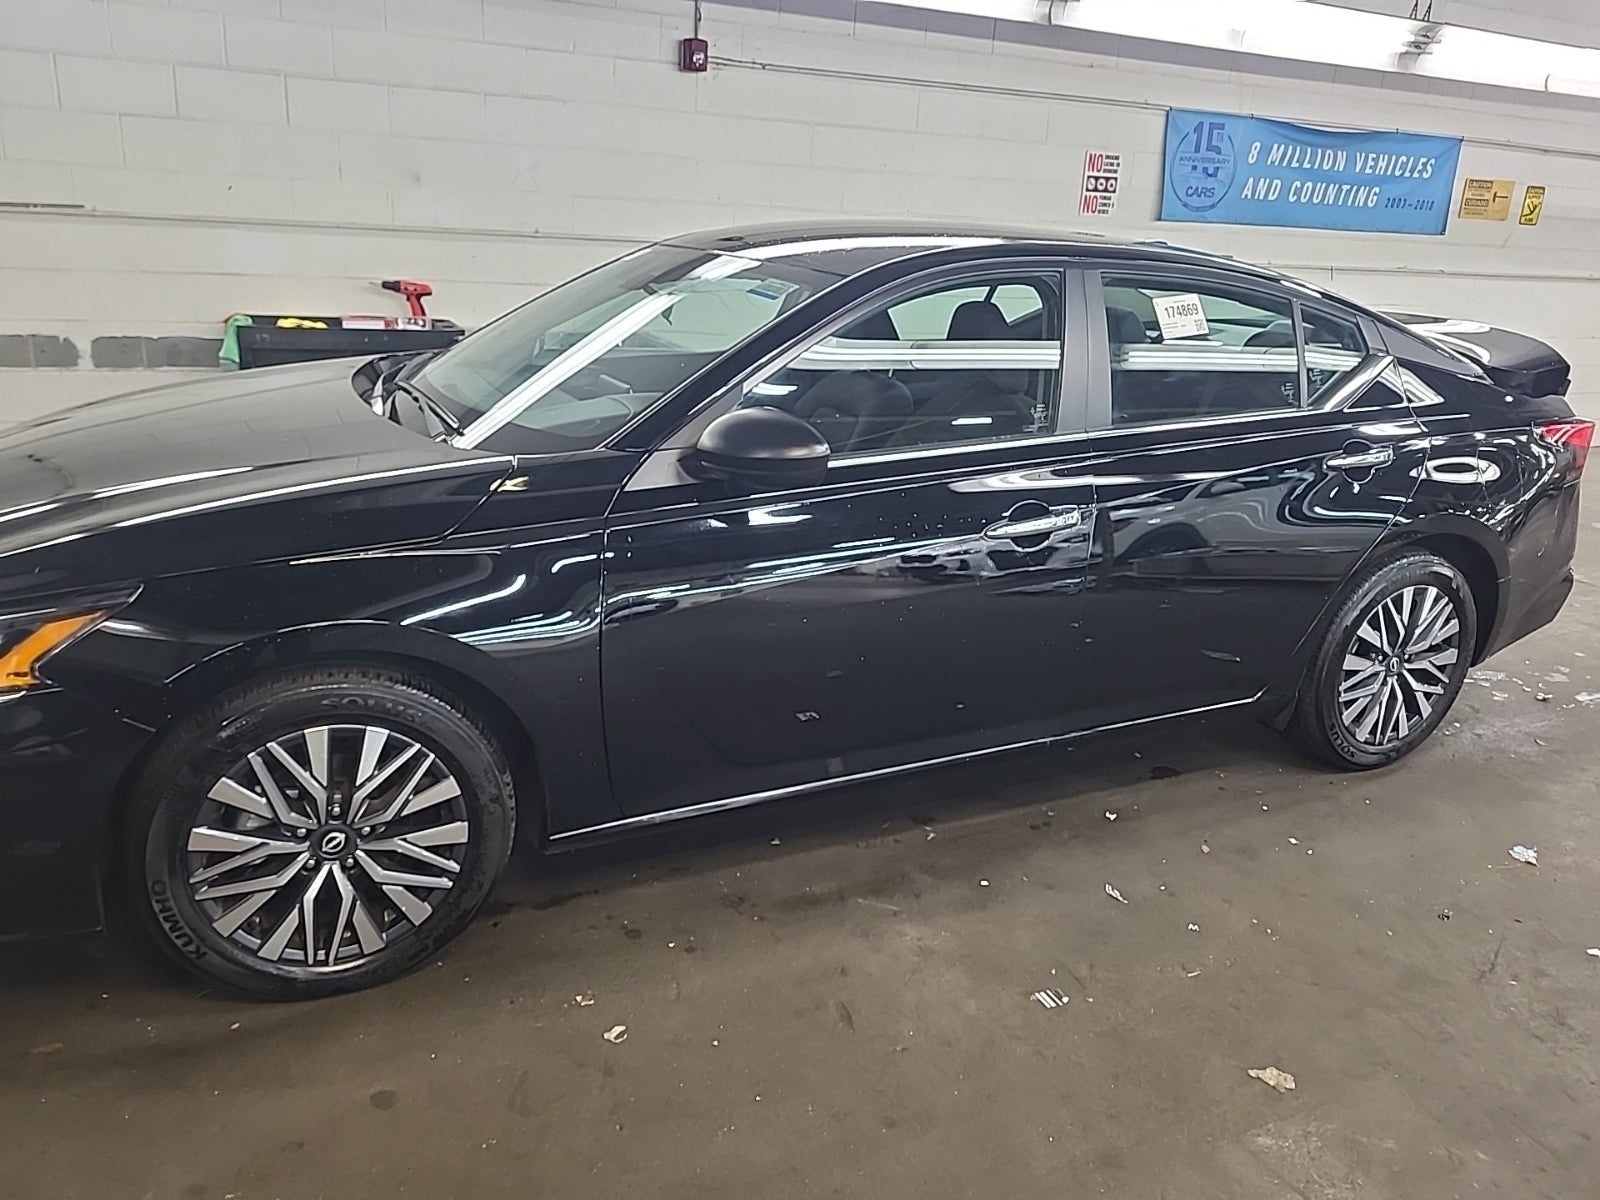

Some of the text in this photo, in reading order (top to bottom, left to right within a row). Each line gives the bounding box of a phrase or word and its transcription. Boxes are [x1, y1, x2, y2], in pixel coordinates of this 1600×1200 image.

[1088, 153, 1104, 173] NO
[1179, 155, 1231, 165] ANNIVERSARY
[1248, 141, 1435, 179] 8 MILLION VEHICLES
[1186, 186, 1215, 198] CARS
[1241, 177, 1281, 201] AND
[1289, 180, 1380, 208] COUNTING
[1082, 194, 1098, 214] NO
[1164, 303, 1199, 319] 174869
[1329, 722, 1356, 759] SOLUS
[152, 880, 208, 960] KUMHO
